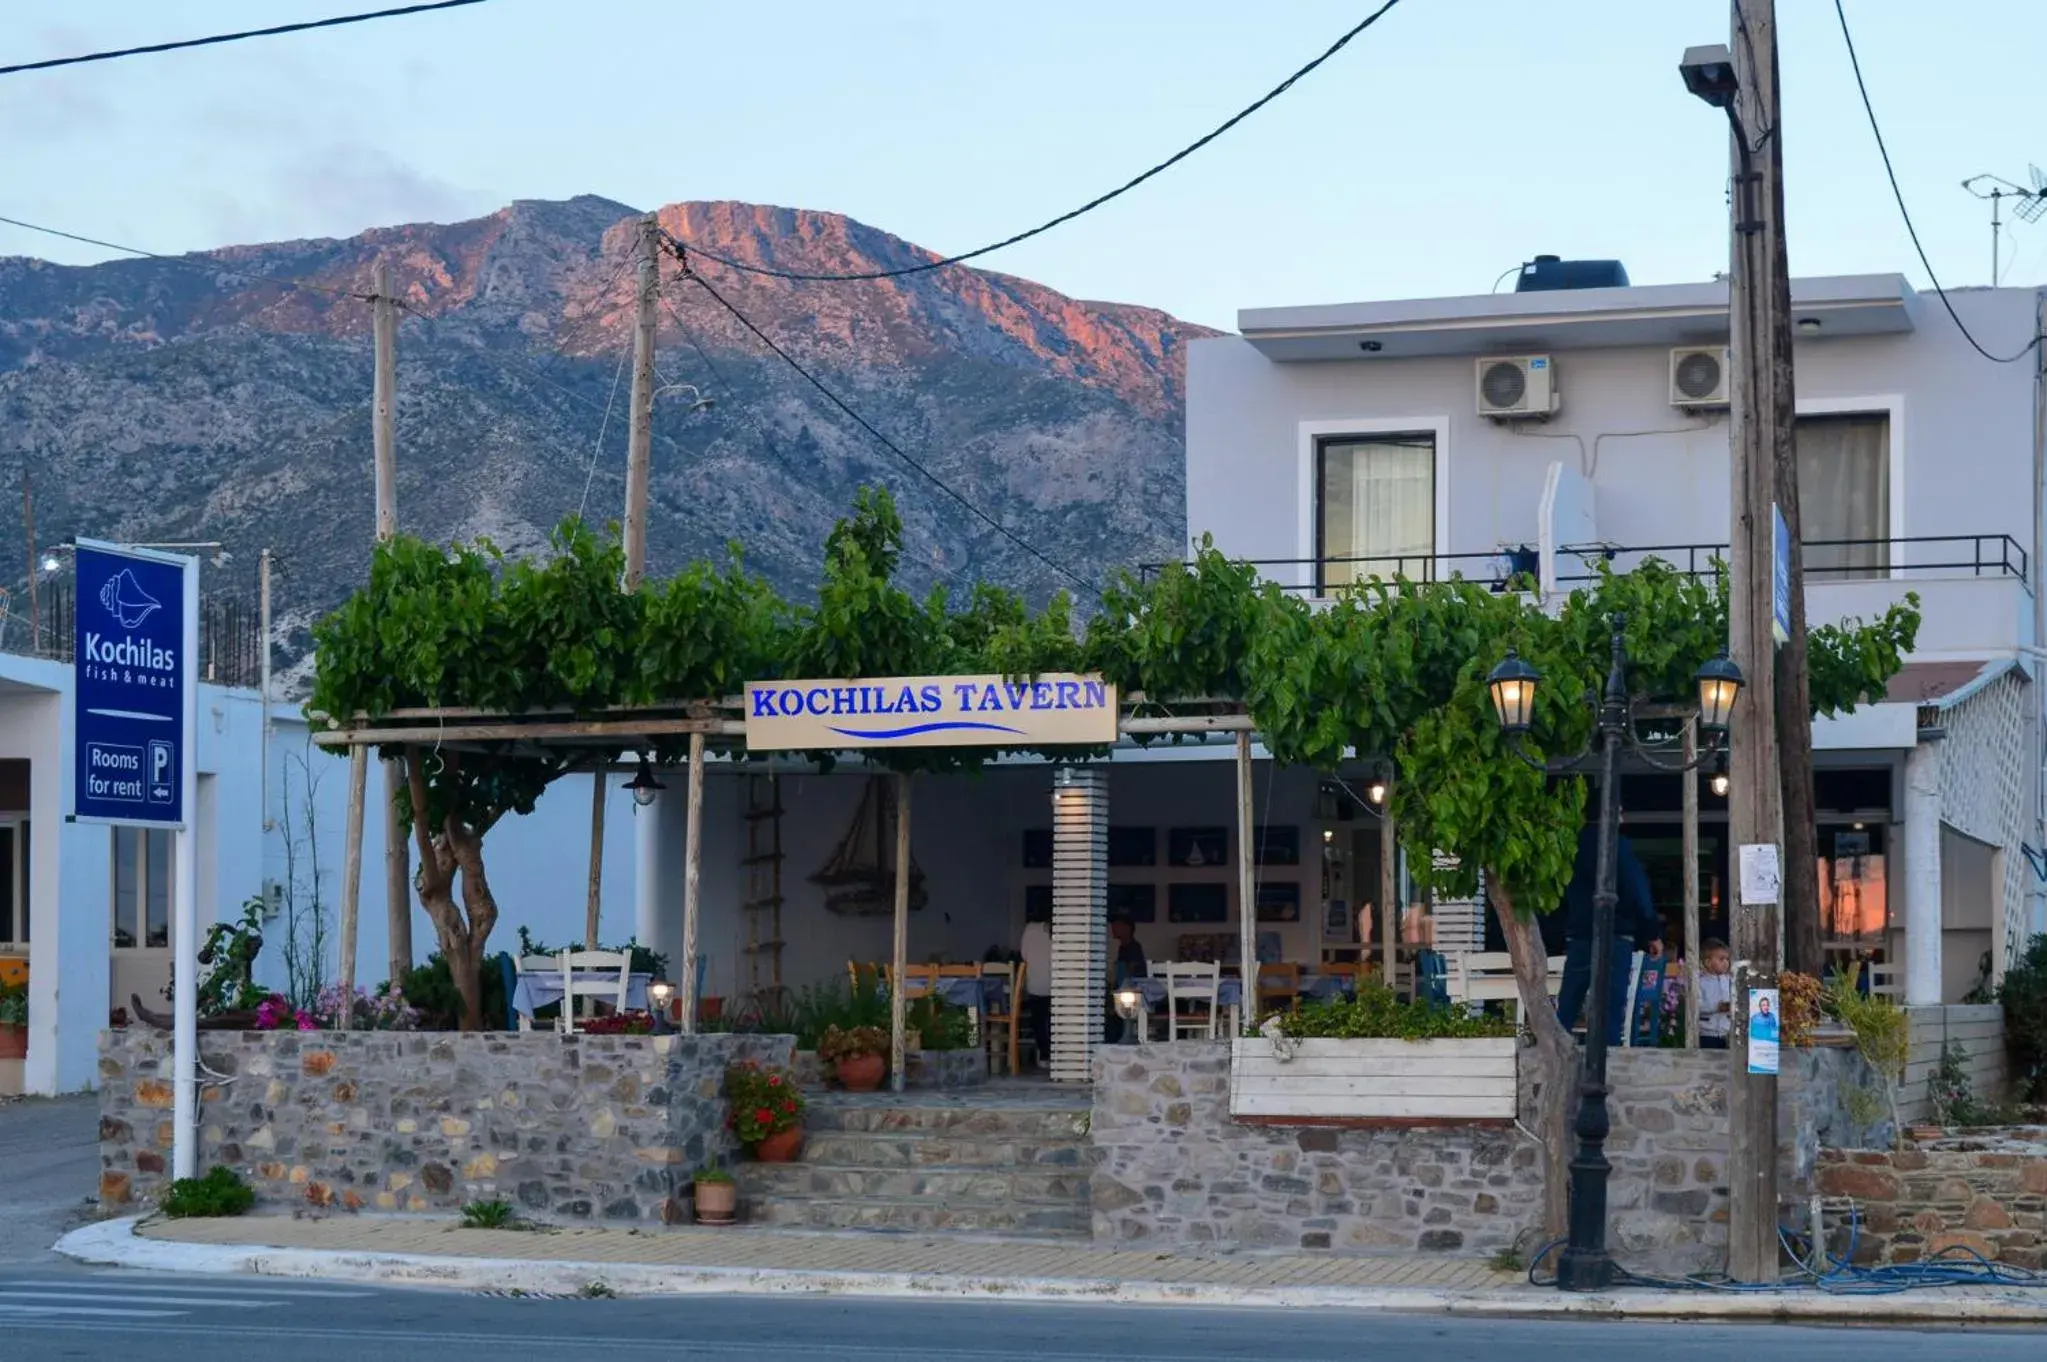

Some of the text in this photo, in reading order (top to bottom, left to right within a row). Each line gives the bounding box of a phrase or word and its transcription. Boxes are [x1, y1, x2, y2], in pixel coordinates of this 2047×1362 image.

[86, 632, 174, 671] Kochilas
[86, 664, 174, 688] fish & meat
[751, 680, 1106, 717] KOCHILAS TAVERN
[92, 748, 139, 770] Rooms
[154, 746, 168, 783] P
[89, 773, 142, 797] for rent
